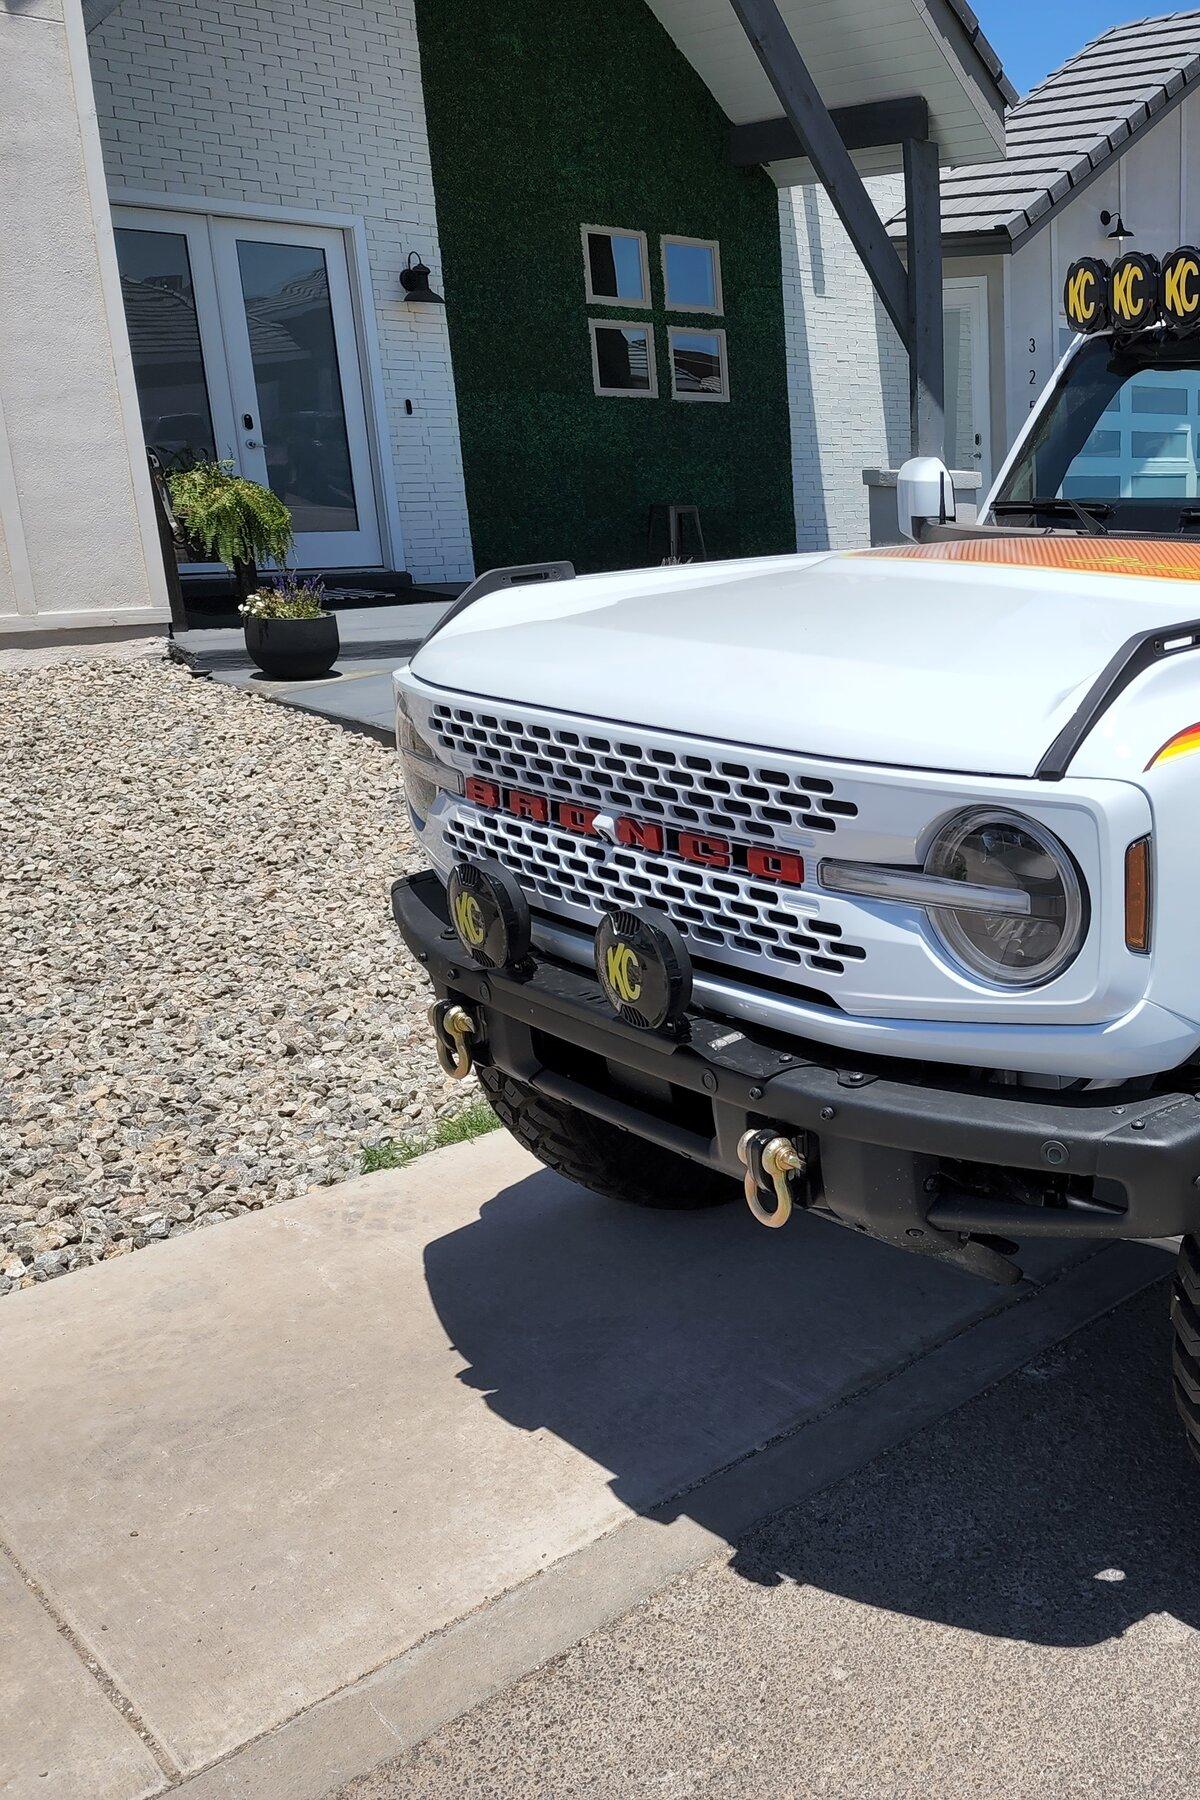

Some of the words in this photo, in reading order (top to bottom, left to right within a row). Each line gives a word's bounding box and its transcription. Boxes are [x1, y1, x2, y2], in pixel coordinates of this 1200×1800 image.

[1069, 268, 1095, 323] KC
[1114, 263, 1144, 320] KC
[1166, 258, 1199, 317] KC
[1029, 338, 1036, 353] 3
[1029, 370, 1036, 384] 2
[466, 776, 805, 883] BRONCO
[456, 891, 484, 945] KC
[607, 943, 642, 1002] KC
